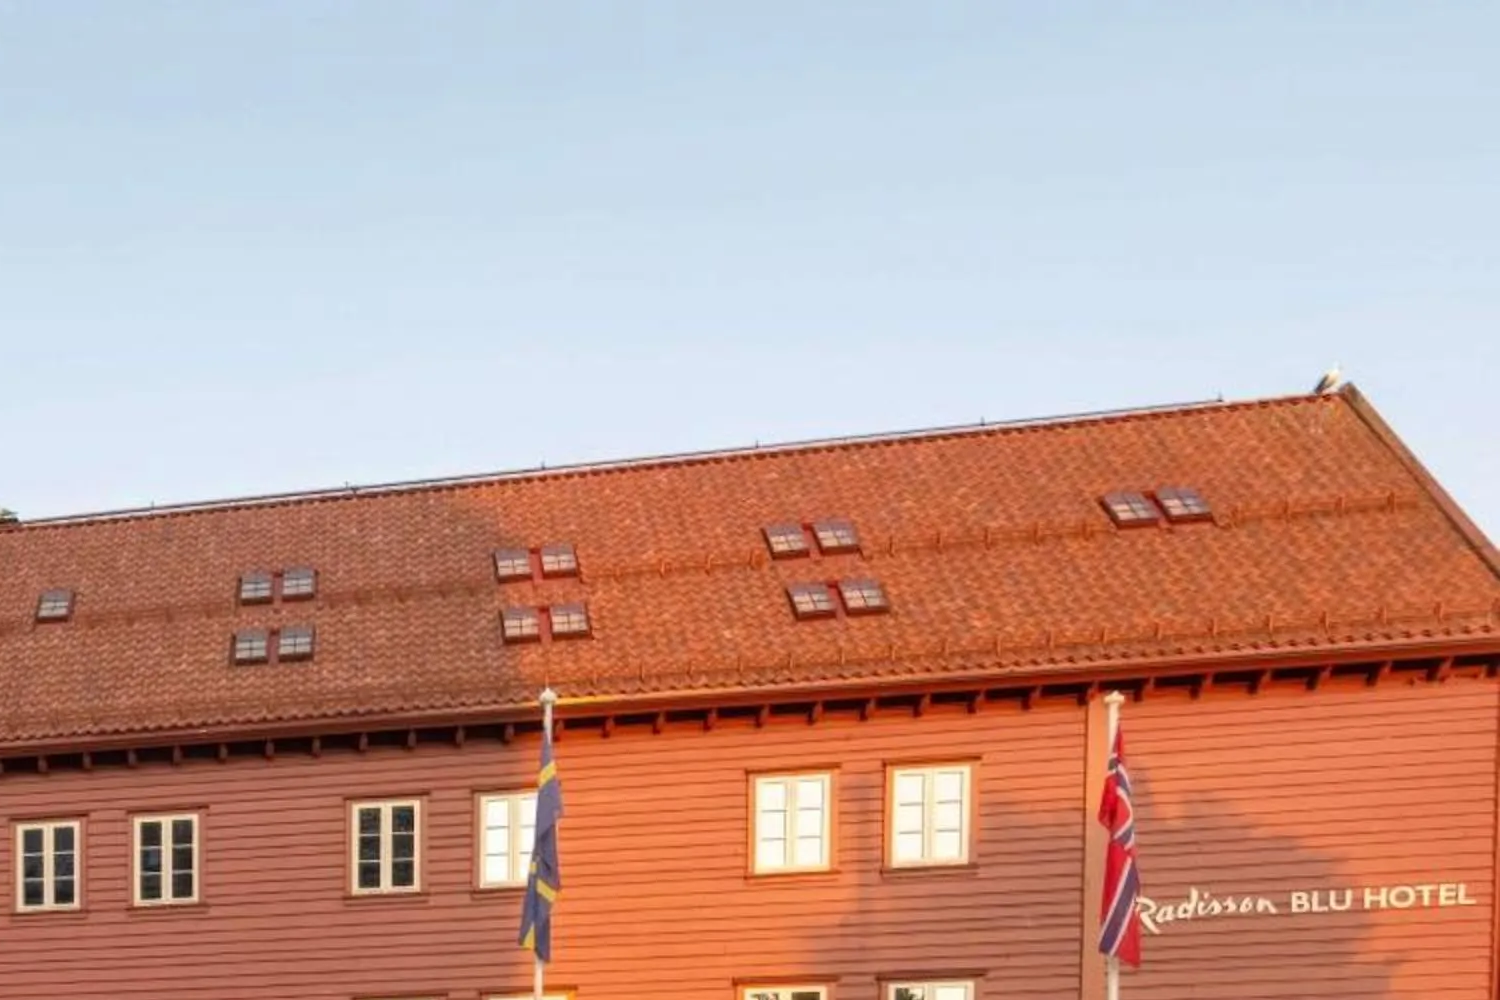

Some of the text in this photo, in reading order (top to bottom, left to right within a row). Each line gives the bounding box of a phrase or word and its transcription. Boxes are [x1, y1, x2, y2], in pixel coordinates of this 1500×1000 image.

[1135, 883, 1477, 934] Radisson BLU HOTEL
